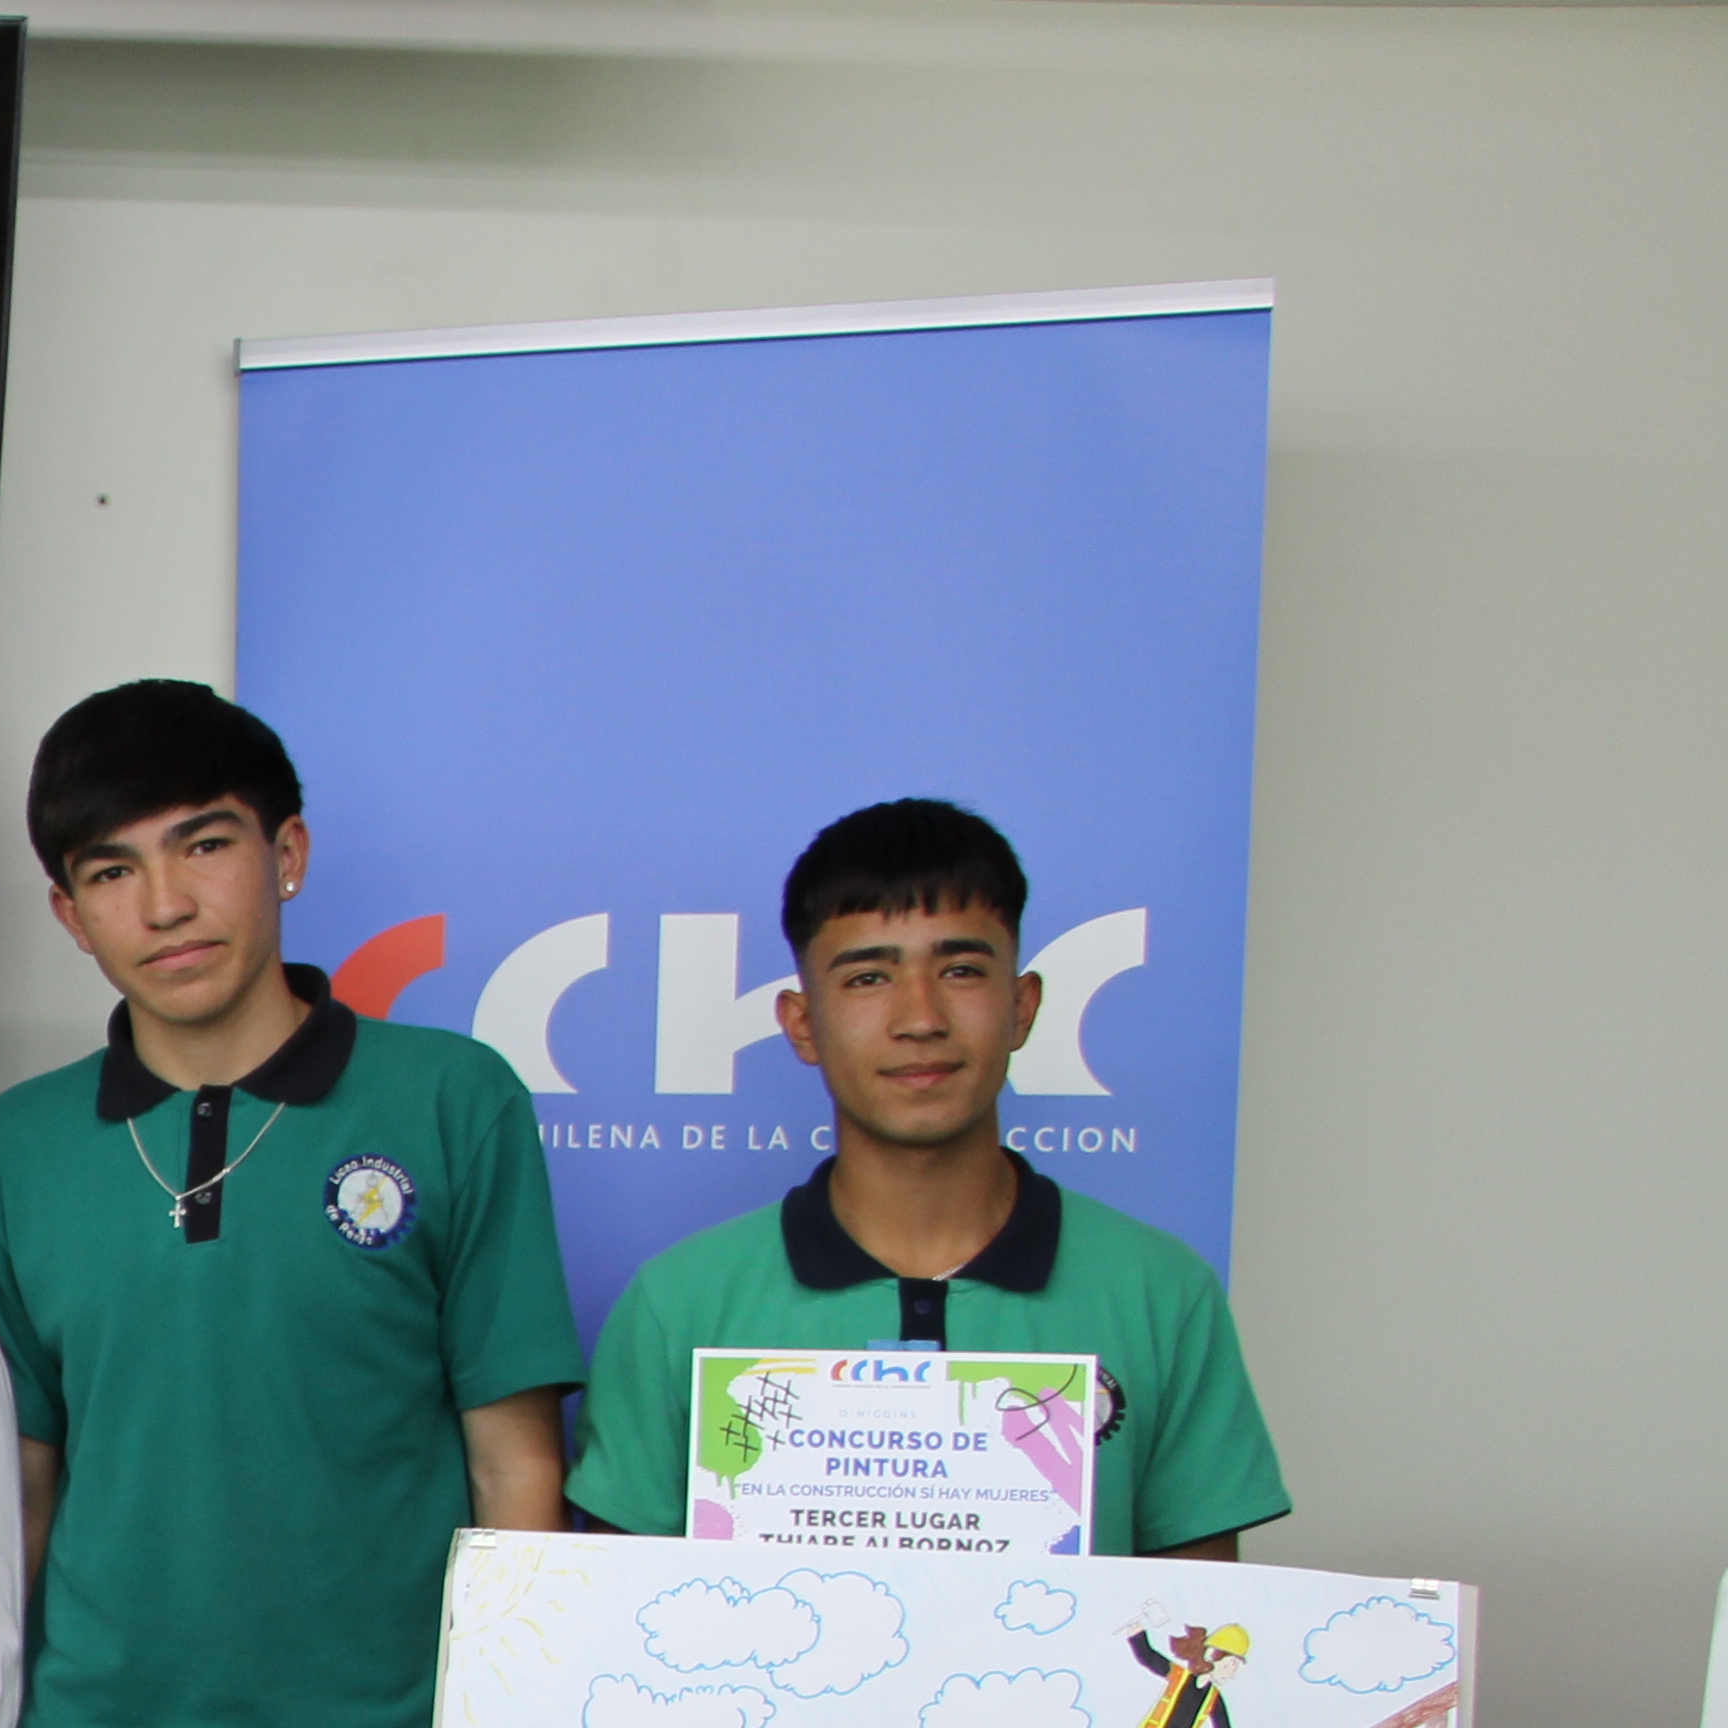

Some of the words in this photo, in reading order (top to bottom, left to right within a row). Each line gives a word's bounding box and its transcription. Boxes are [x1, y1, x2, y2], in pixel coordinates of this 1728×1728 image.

[682, 1125, 726, 1150] DE
[748, 1125, 789, 1150] LA
[788, 1428, 944, 1451] CONCURSO
[952, 1432, 988, 1451] DE
[825, 1457, 949, 1479] PINTURA
[766, 1484, 786, 1496] LA
[789, 1483, 917, 1500] CONSTRUCCIÓN
[920, 1484, 934, 1500] SÍ
[938, 1487, 972, 1500] HAY
[790, 1508, 887, 1528] TERCER
[894, 1512, 982, 1531] LUGAR
